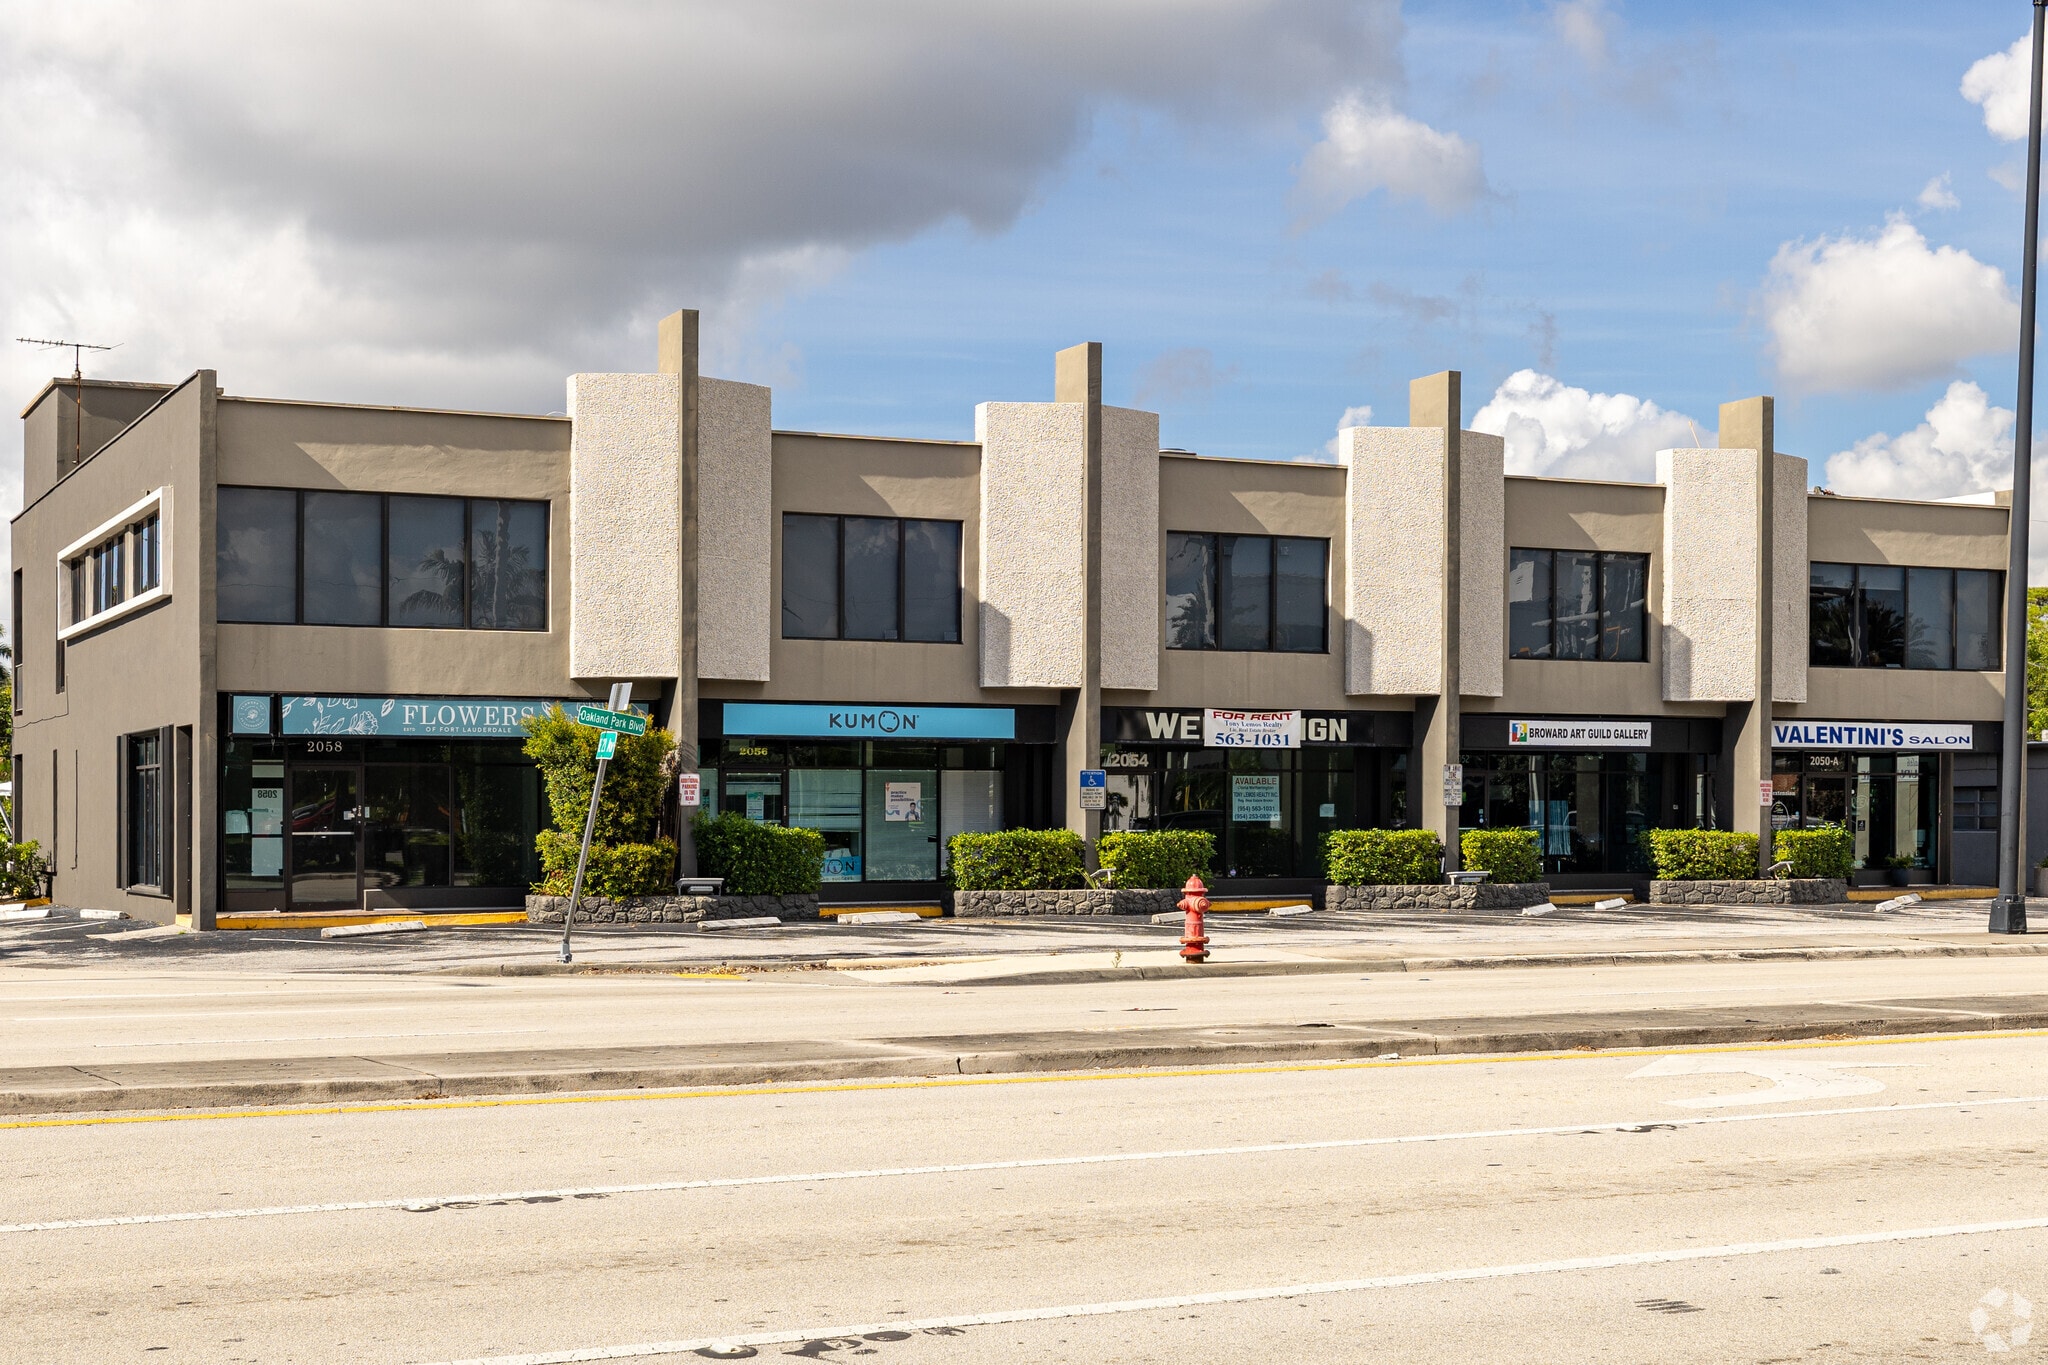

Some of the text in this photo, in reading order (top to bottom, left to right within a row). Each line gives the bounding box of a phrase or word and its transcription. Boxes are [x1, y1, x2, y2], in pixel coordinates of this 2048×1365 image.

[402, 705, 535, 726] FLOWERS
[580, 710, 644, 732] Oakland Park Blvd
[829, 710, 916, 733] KUMON
[1213, 711, 1245, 720] FOR
[1224, 720, 1239, 728] Tony
[1263, 721, 1283, 729] Realty
[1215, 733, 1289, 746] 563-1031
[1529, 728, 1649, 740] BROWARD ART GUILD GALLERY
[1774, 726, 1904, 746] VALENTINI'S
[1909, 736, 1971, 744] SALON
[307, 741, 343, 752] 2058
[739, 747, 768, 755] 2056
[1110, 754, 1149, 767] 2054
[1810, 756, 1839, 766] 2050-A
[1235, 777, 1277, 785] AVAILABLE
